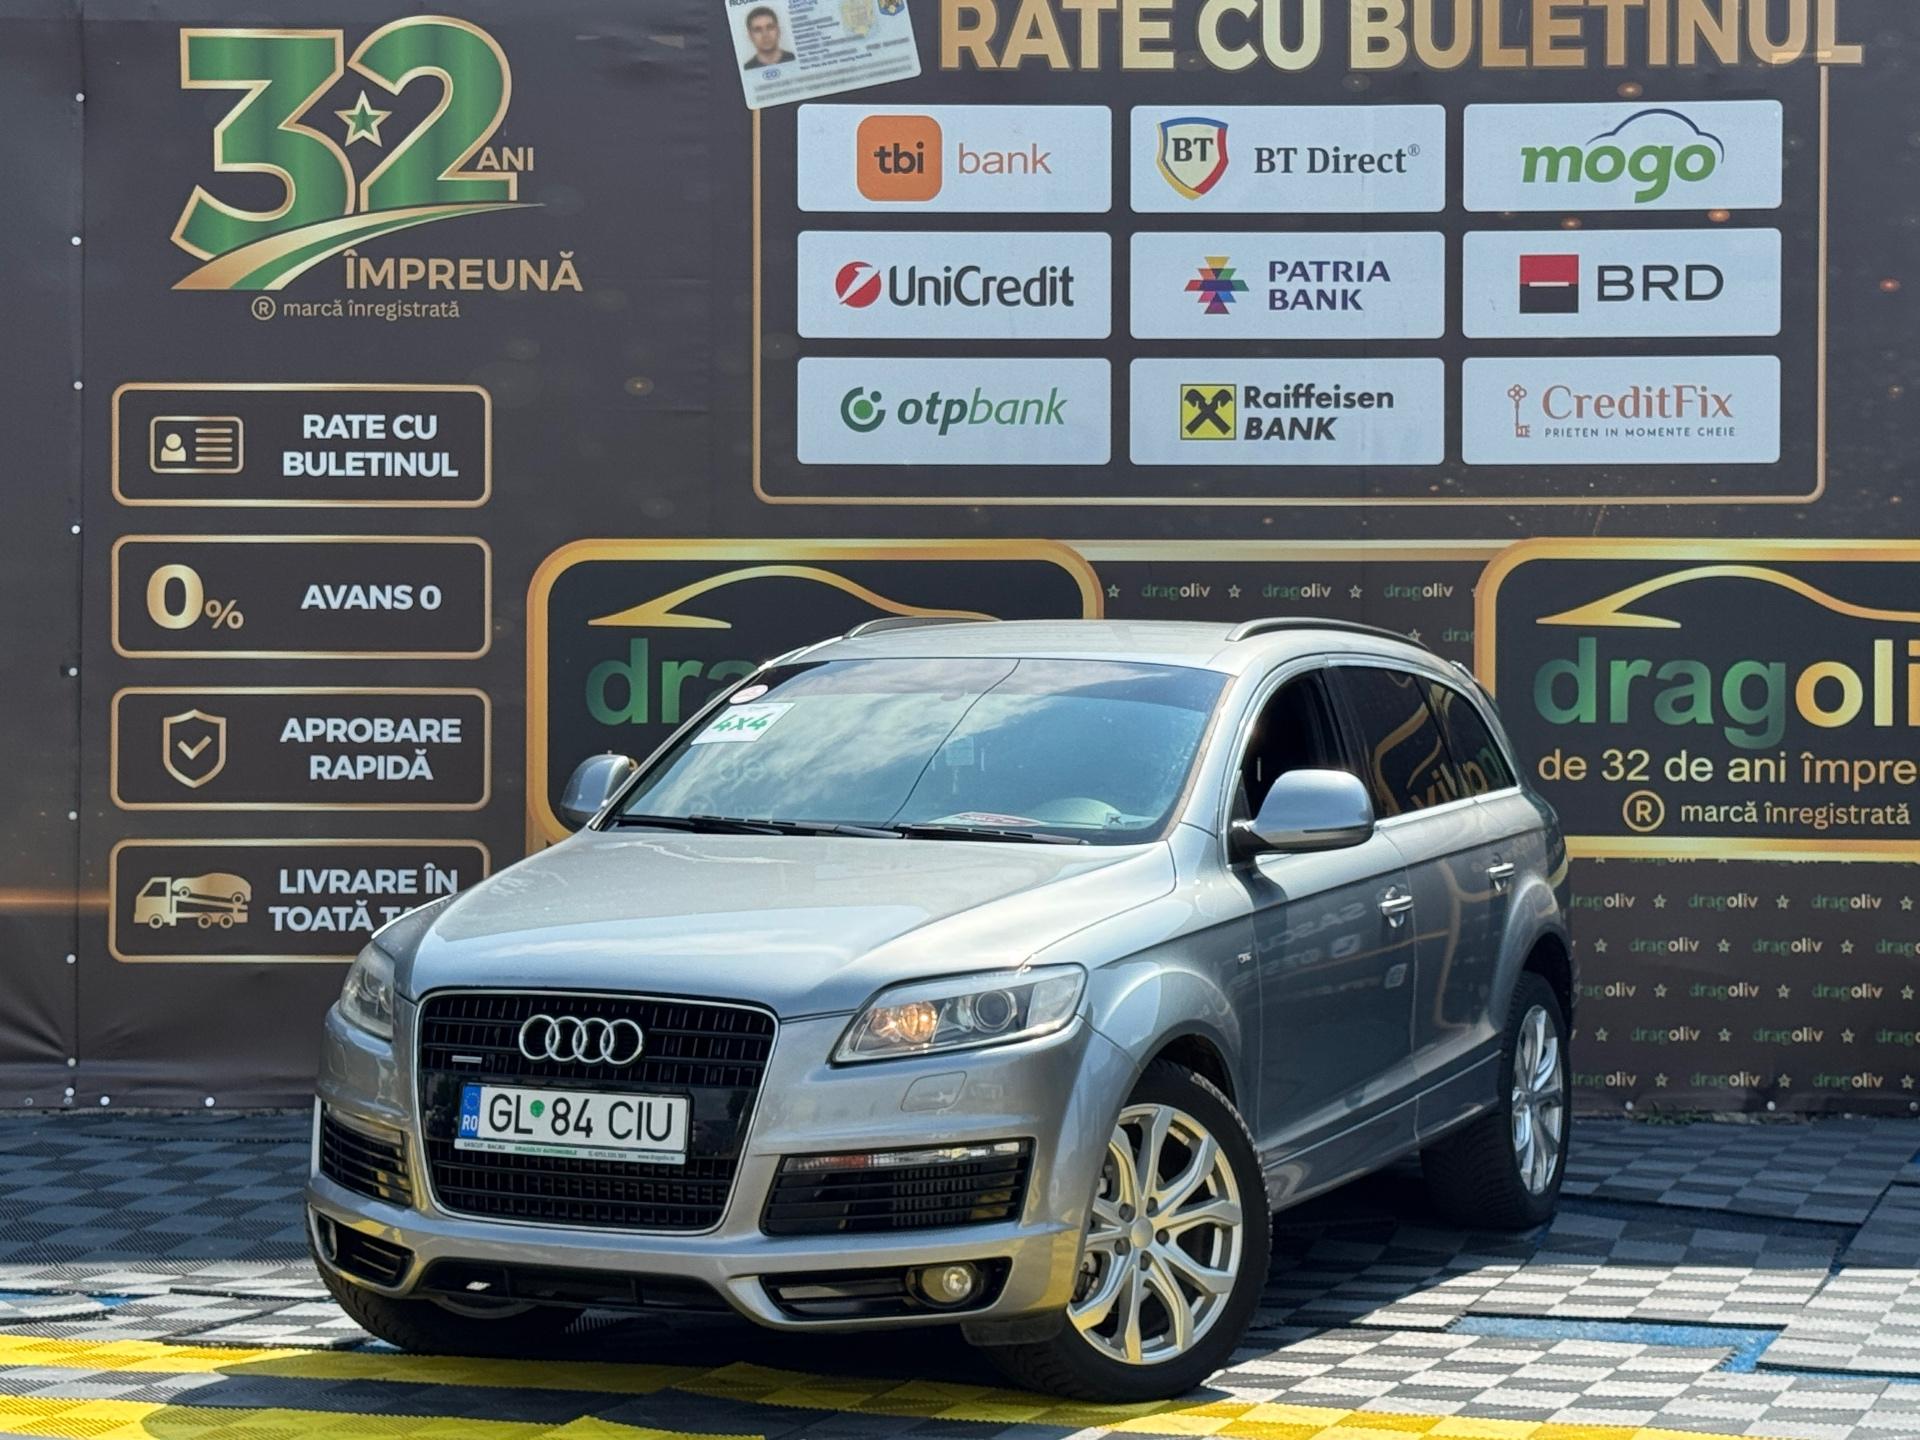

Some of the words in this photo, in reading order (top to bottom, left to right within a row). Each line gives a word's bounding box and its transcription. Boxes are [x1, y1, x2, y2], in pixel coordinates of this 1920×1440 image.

[941, 0, 1174, 69] RATE
[1198, 0, 1321, 70] CU
[1350, 0, 1862, 69] BULETINUL
[171, 15, 517, 262] 32
[477, 147, 534, 171] ANI
[1172, 138, 1213, 161] BT
[874, 141, 924, 174] tbi
[959, 143, 1052, 174] bank
[1255, 148, 1297, 173] BT
[1521, 144, 1716, 203] mogo
[343, 249, 583, 291] ÎMPREUNĂ
[1269, 261, 1390, 282] PATRIA
[1598, 264, 1723, 301] BRD
[889, 266, 1074, 306] UniCredit
[284, 299, 343, 316] marcă
[348, 299, 460, 321] înregistrată
[1269, 289, 1363, 310] BANK
[1244, 383, 1393, 409] Raiffeisen
[1543, 385, 1733, 420] CreditFix
[898, 387, 1067, 436] otpbank
[304, 414, 385, 439] RATE
[393, 415, 437, 439] CU
[1244, 417, 1337, 440] BANK
[1545, 428, 1598, 437] PRIETEN
[1606, 428, 1618, 437] IN
[1625, 427, 1690, 437] MOMENTE
[1697, 427, 1735, 436] CHEIE
[283, 452, 458, 477] BULETINUL
[301, 585, 413, 610] AVANS
[420, 585, 441, 610] 0
[1142, 583, 1211, 601] dragoliv
[1262, 583, 1331, 601] dragoliv
[1384, 583, 1453, 601] dragoliv
[280, 718, 461, 743] APROBARE
[310, 749, 433, 780] RAPIDĂ
[1539, 749, 1587, 780] de
[1602, 749, 1649, 781] 32
[1665, 750, 1713, 782] de
[1728, 751, 1785, 782] ani
[1681, 801, 1758, 822] marcă
[1764, 801, 1910, 829] înregistrată
[280, 869, 417, 894] LIVRARE
[424, 863, 457, 894] ÎN
[1688, 893, 1758, 911] dragoliv
[1812, 893, 1881, 912] dragoliv
[268, 900, 374, 931] TOATĂ
[1630, 937, 1699, 955] dragoliv
[1753, 937, 1822, 956] dragoliv
[1577, 982, 1636, 999] ragoliv
[1690, 982, 1759, 1000] dragoliv
[1813, 983, 1883, 1000] dragoliv
[1632, 1026, 1700, 1044] dragoliv
[1753, 1027, 1824, 1045] dragoliv
[1691, 1071, 1760, 1089] dragoliv
[1813, 1072, 1883, 1089] dragoliv
[462, 1115, 479, 1132] RO
[489, 1094, 533, 1134] GL
[551, 1097, 593, 1138] 84
[609, 1101, 672, 1141] CIU
